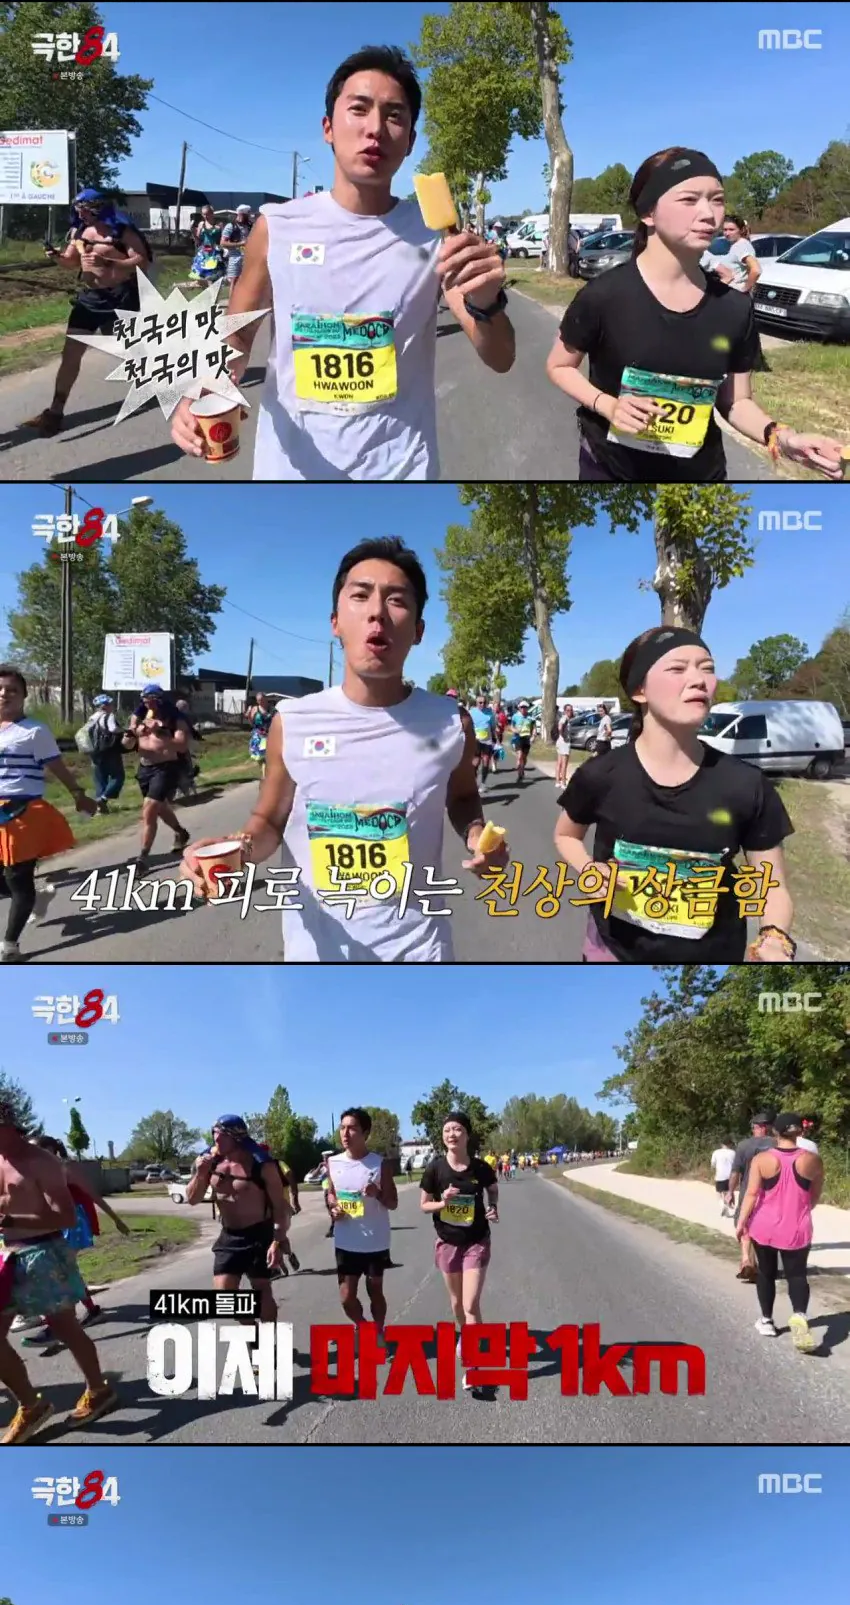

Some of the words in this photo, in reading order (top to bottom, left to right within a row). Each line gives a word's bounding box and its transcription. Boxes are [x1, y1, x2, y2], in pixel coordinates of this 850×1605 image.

[310, 351, 374, 379] 1816
[313, 380, 374, 391] HWAWOON
[325, 843, 387, 869] 1816
